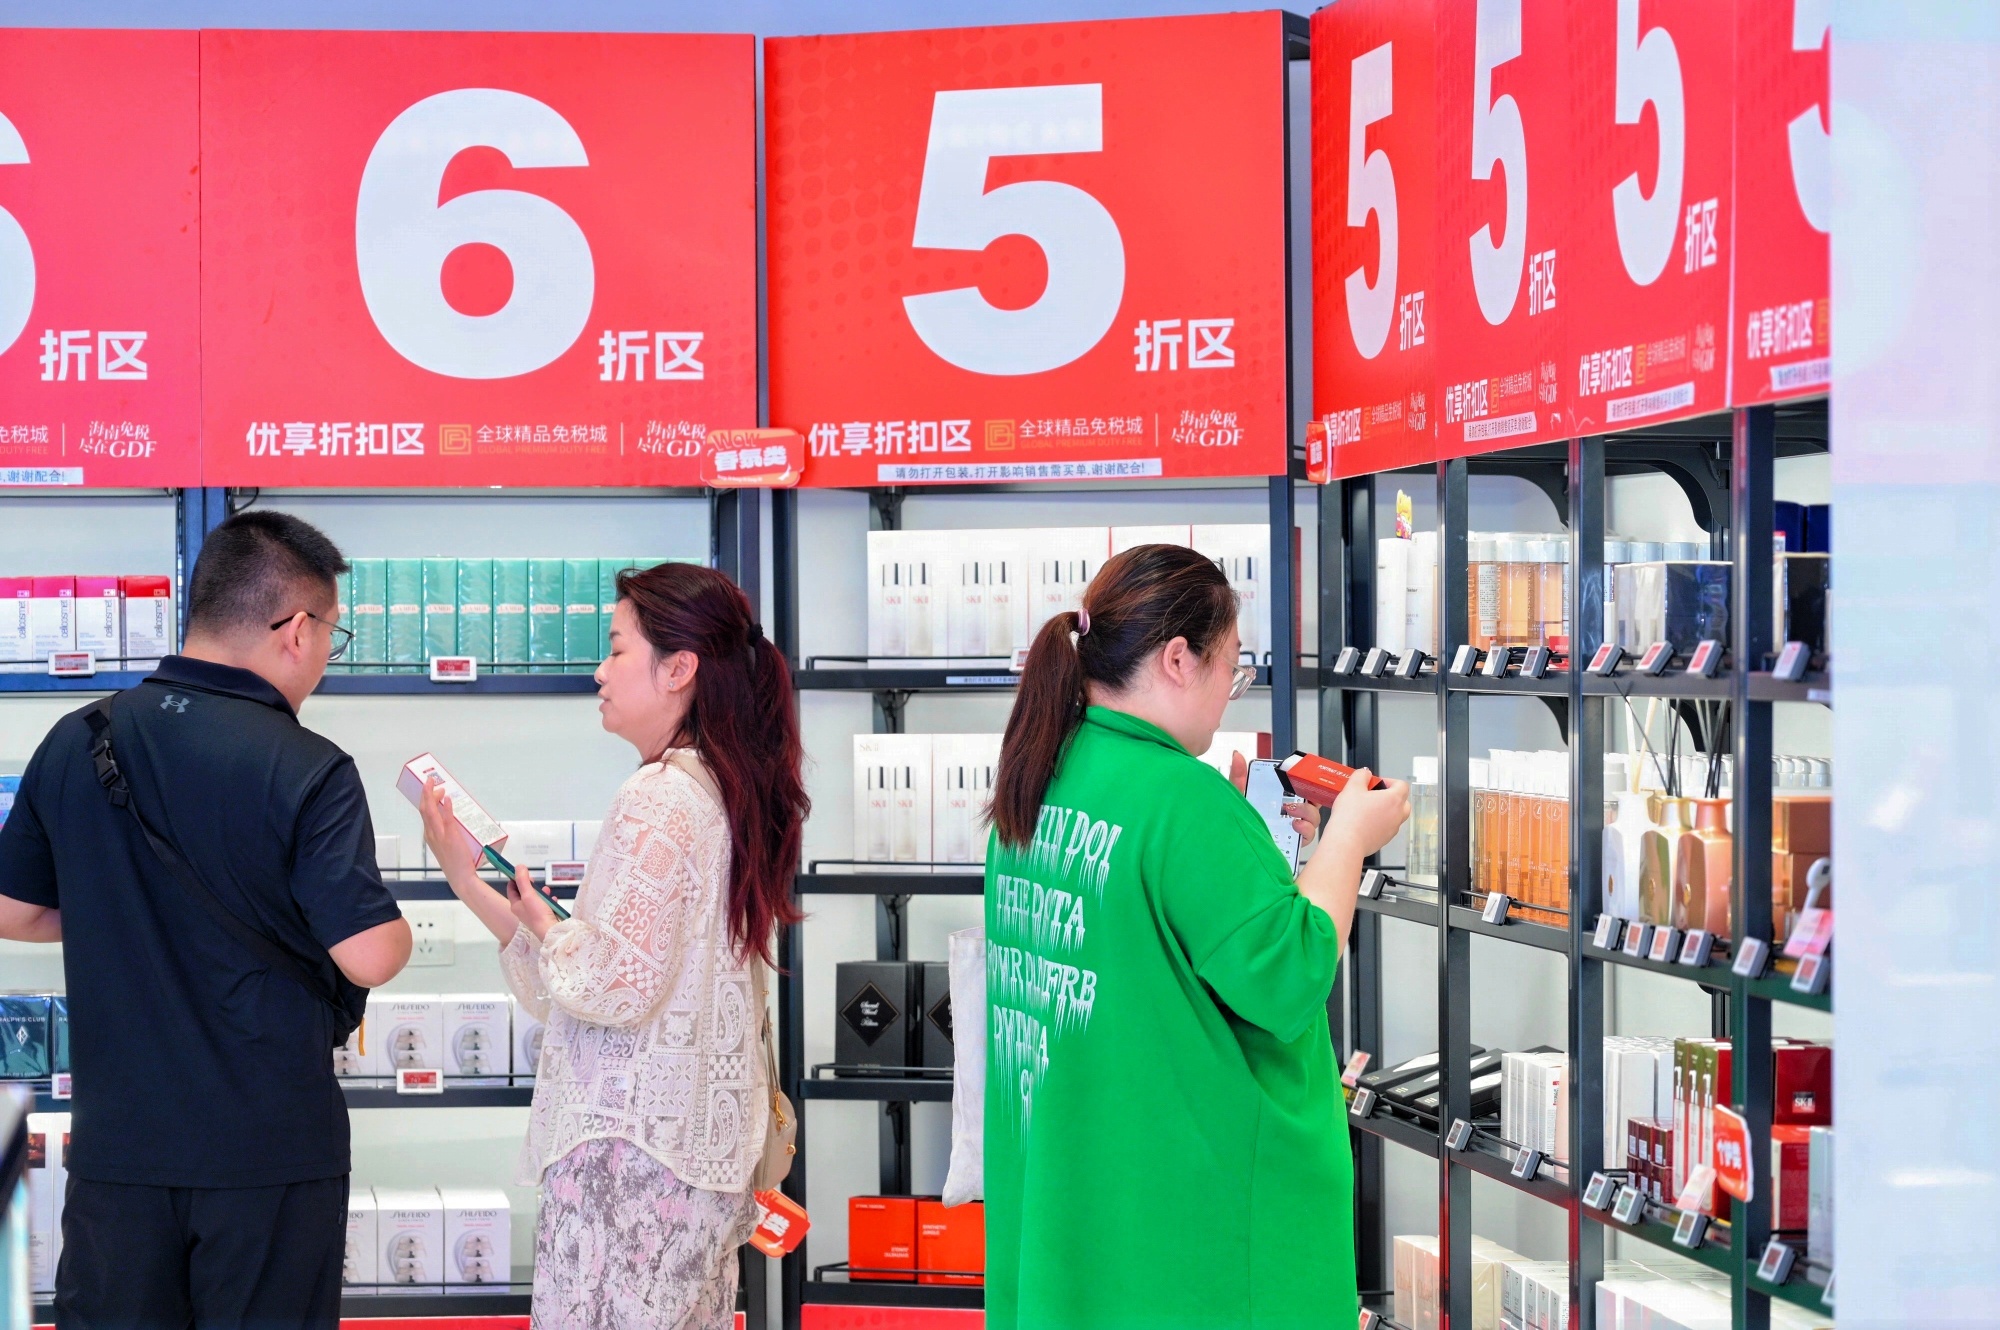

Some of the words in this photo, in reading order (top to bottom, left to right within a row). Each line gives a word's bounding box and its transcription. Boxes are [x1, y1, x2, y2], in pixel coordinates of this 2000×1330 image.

[1468, 0, 1528, 325] 5
[1612, 0, 1685, 286] 5
[1344, 41, 1398, 359] 5
[355, 88, 595, 380] 6
[902, 82, 1126, 376] 5
[1684, 197, 1718, 274] 折区
[1529, 249, 1556, 316] 折区
[1400, 290, 1425, 351] 折区
[39, 329, 148, 381] 折区
[598, 330, 704, 381] 折区
[1134, 318, 1236, 372] 折区
[1579, 345, 1633, 397] 优享折扣区
[1180, 409, 1237, 429] 海南免税
[1445, 379, 1488, 424] 优享折扣区
[89, 420, 150, 440] 海南免税
[246, 421, 425, 456] 优享折扣区
[476, 424, 608, 444] 全球精品免税城
[808, 419, 971, 457] 优享折扣区
[1019, 415, 1143, 438] 全球精品免税城
[1171, 427, 1245, 448] 尽在GDF
[637, 437, 706, 458] 尽在GD
[715, 445, 787, 472] 香氛类
[392, 1003, 430, 1011] SHISEIDO
[456, 1003, 495, 1011] SHISEIDO
[390, 1211, 430, 1219] SHISEIDO
[457, 1210, 497, 1218] SHISEIDO
